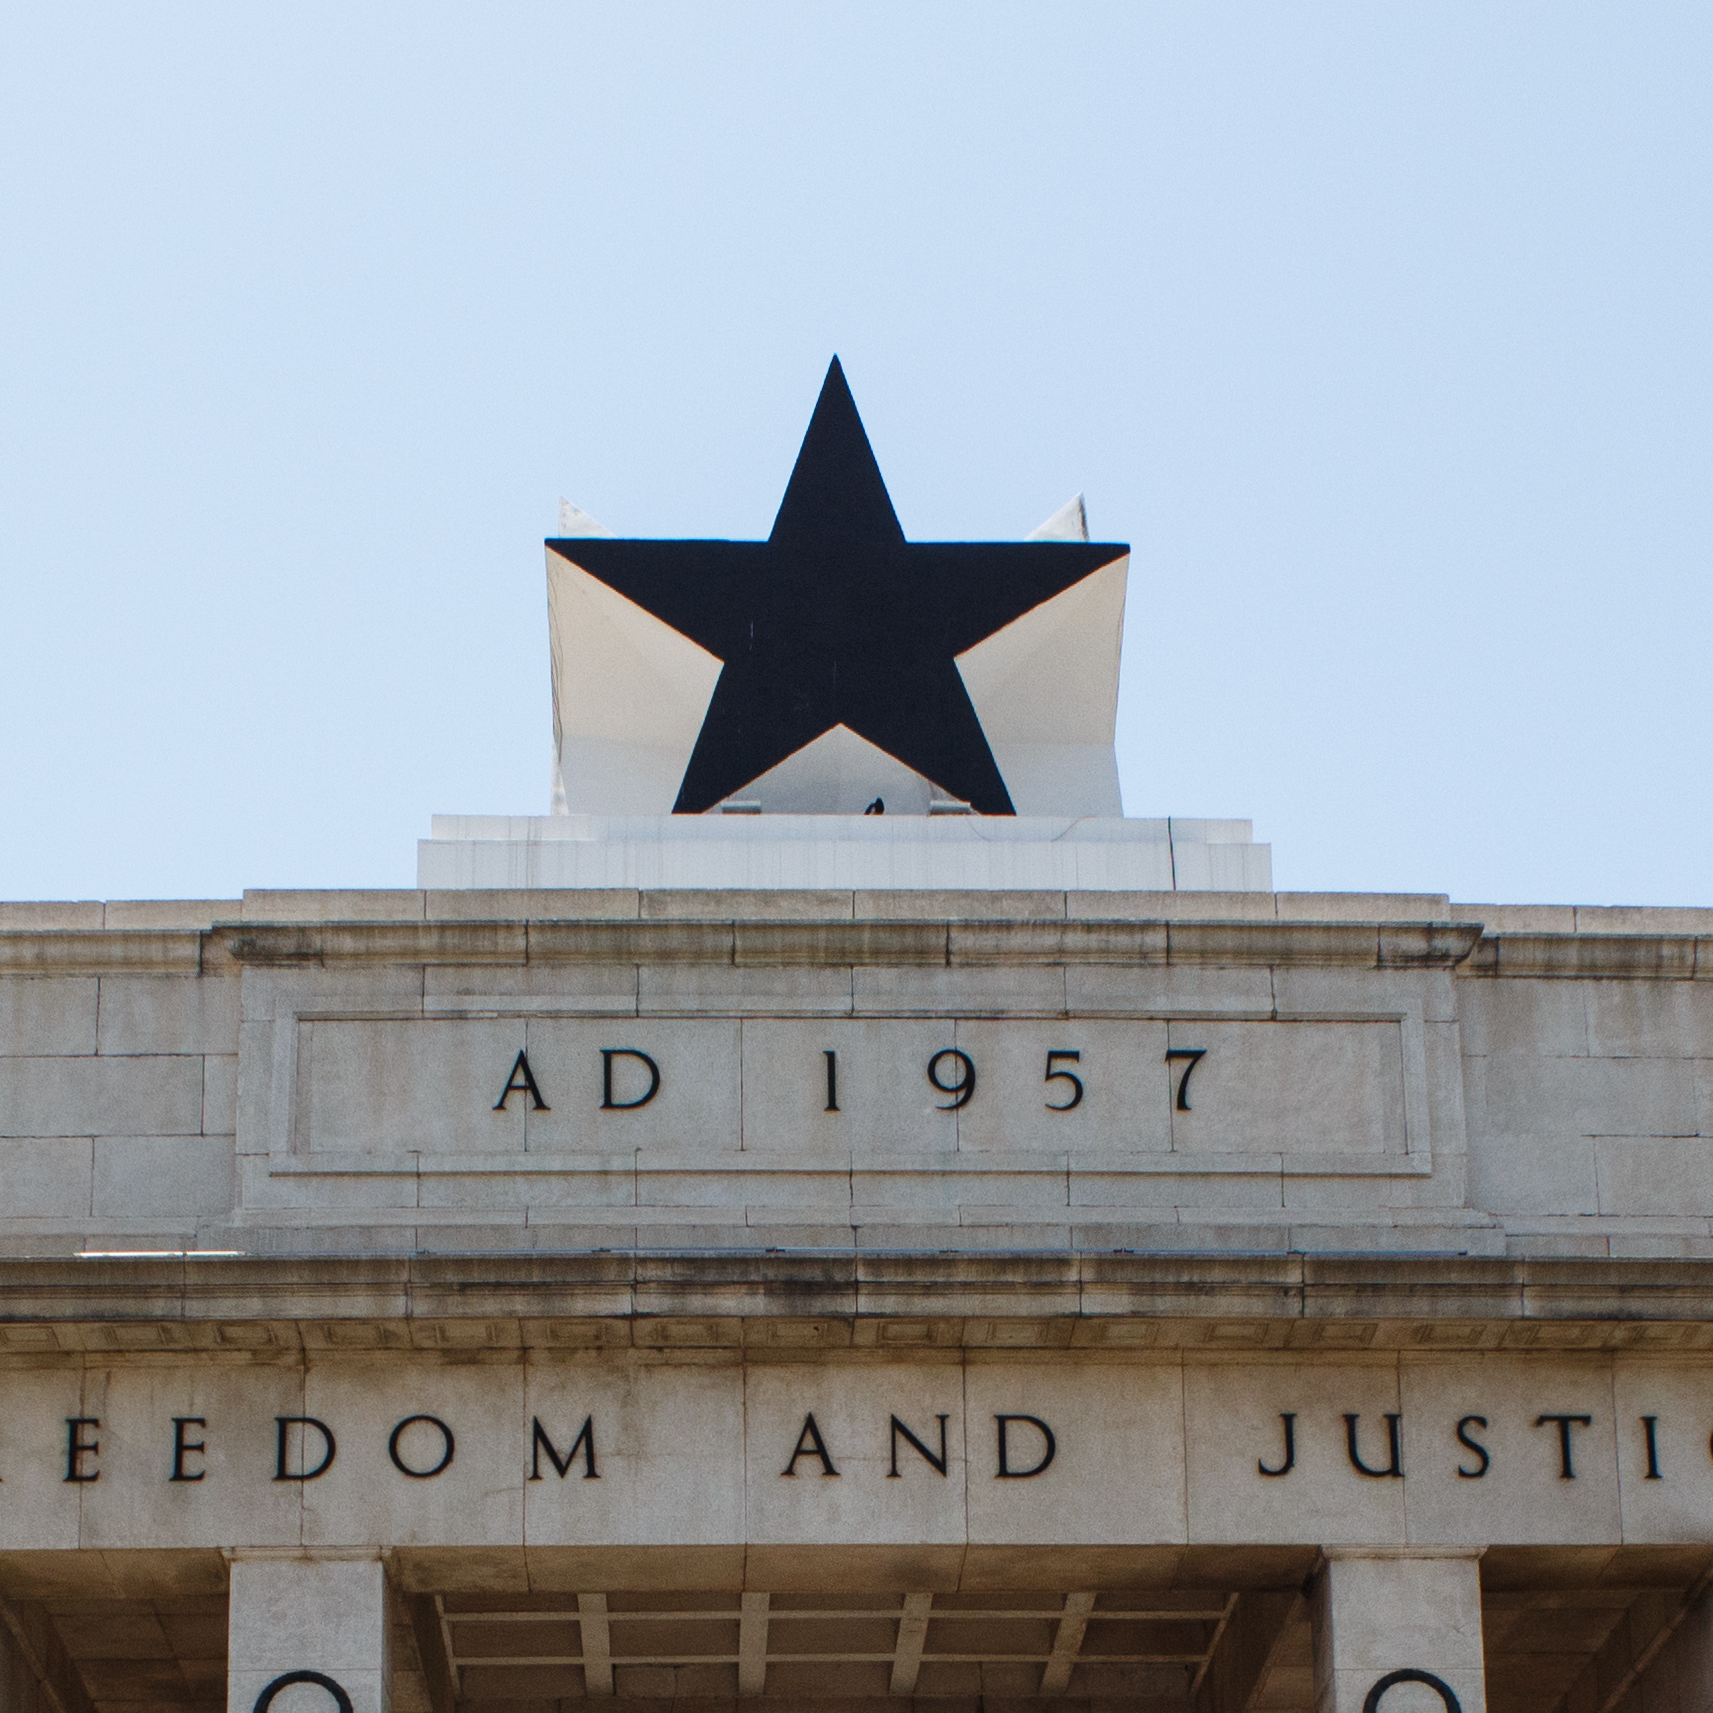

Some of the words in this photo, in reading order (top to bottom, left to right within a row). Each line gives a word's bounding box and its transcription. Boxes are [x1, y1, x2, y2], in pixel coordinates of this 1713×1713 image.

[491, 1047, 662, 1113] AD
[822, 1047, 1209, 1114] 1957
[780, 1411, 1057, 1479] AND
